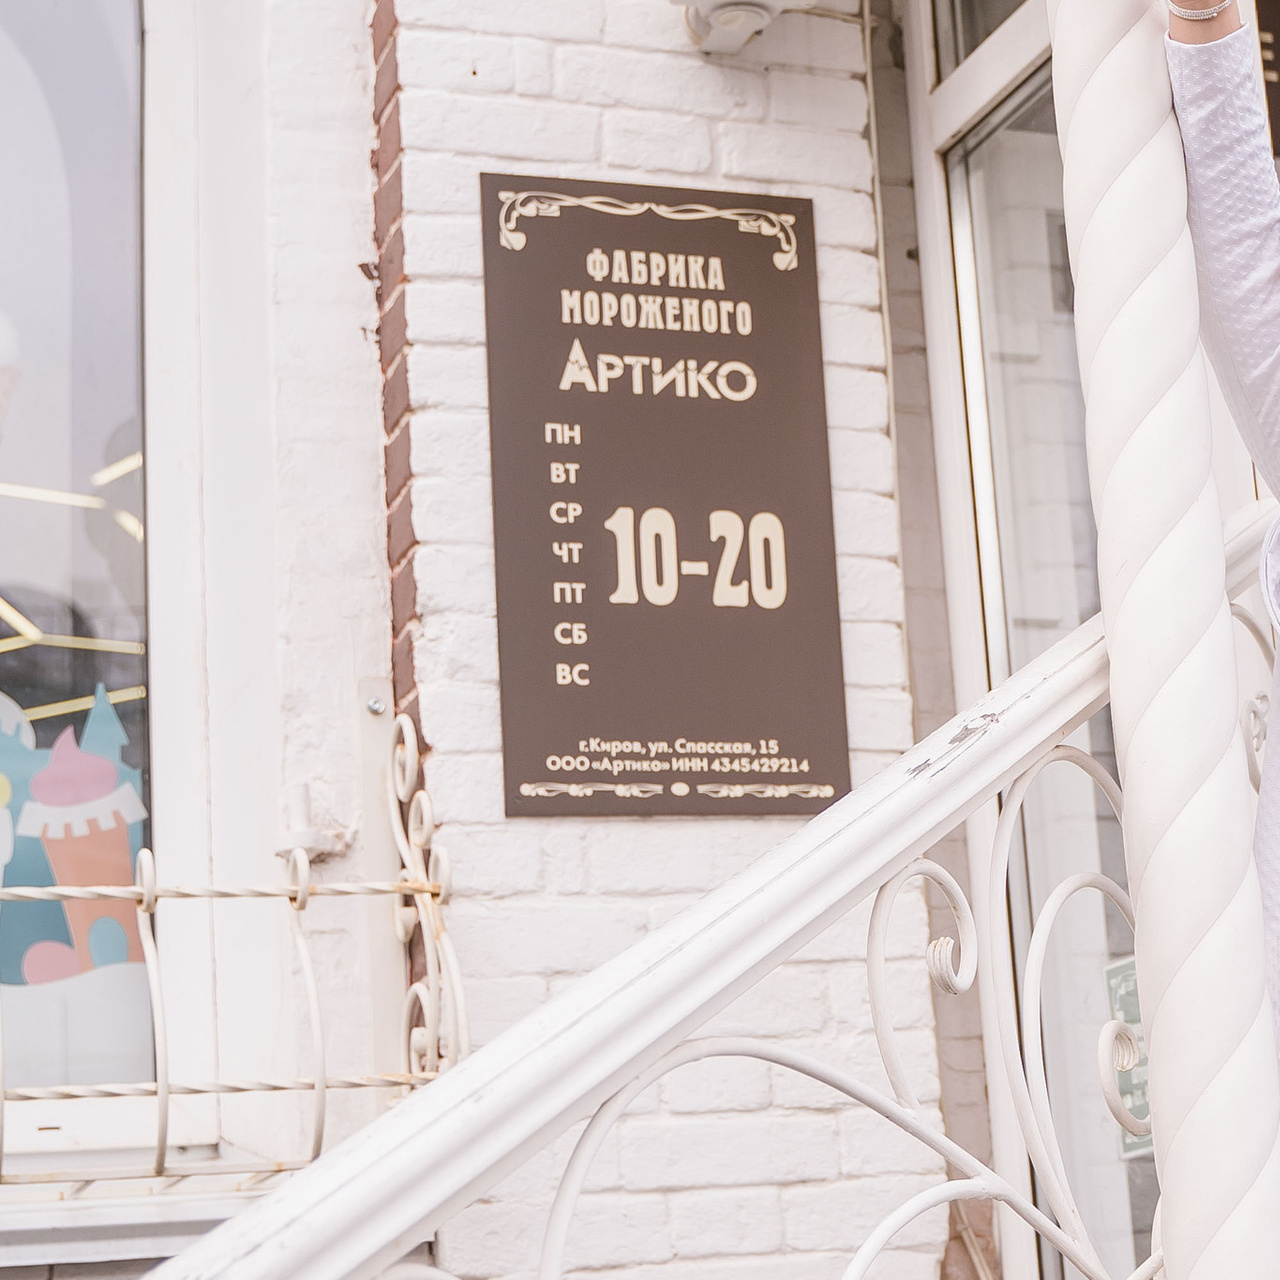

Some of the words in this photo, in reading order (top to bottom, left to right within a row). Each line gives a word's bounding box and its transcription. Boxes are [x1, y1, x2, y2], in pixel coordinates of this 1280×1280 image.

[586, 247, 725, 291] ФАБРИКА
[560, 288, 753, 336] МОРОЖЕНОГО
[544, 422, 582, 445] ПН
[549, 462, 581, 484] ВТ
[549, 501, 583, 524] СР
[552, 541, 584, 564] ЧТ
[603, 506, 788, 610] 10-20
[553, 581, 586, 604] ПТ
[553, 621, 588, 645] СБ
[555, 662, 591, 686] ВС
[648, 740, 673, 758] ул.
[674, 738, 757, 756] Спасская,
[759, 739, 780, 756] 15
[546, 755, 591, 772] ООО
[671, 757, 709, 772] ИНН
[710, 758, 810, 773] 4345429214
